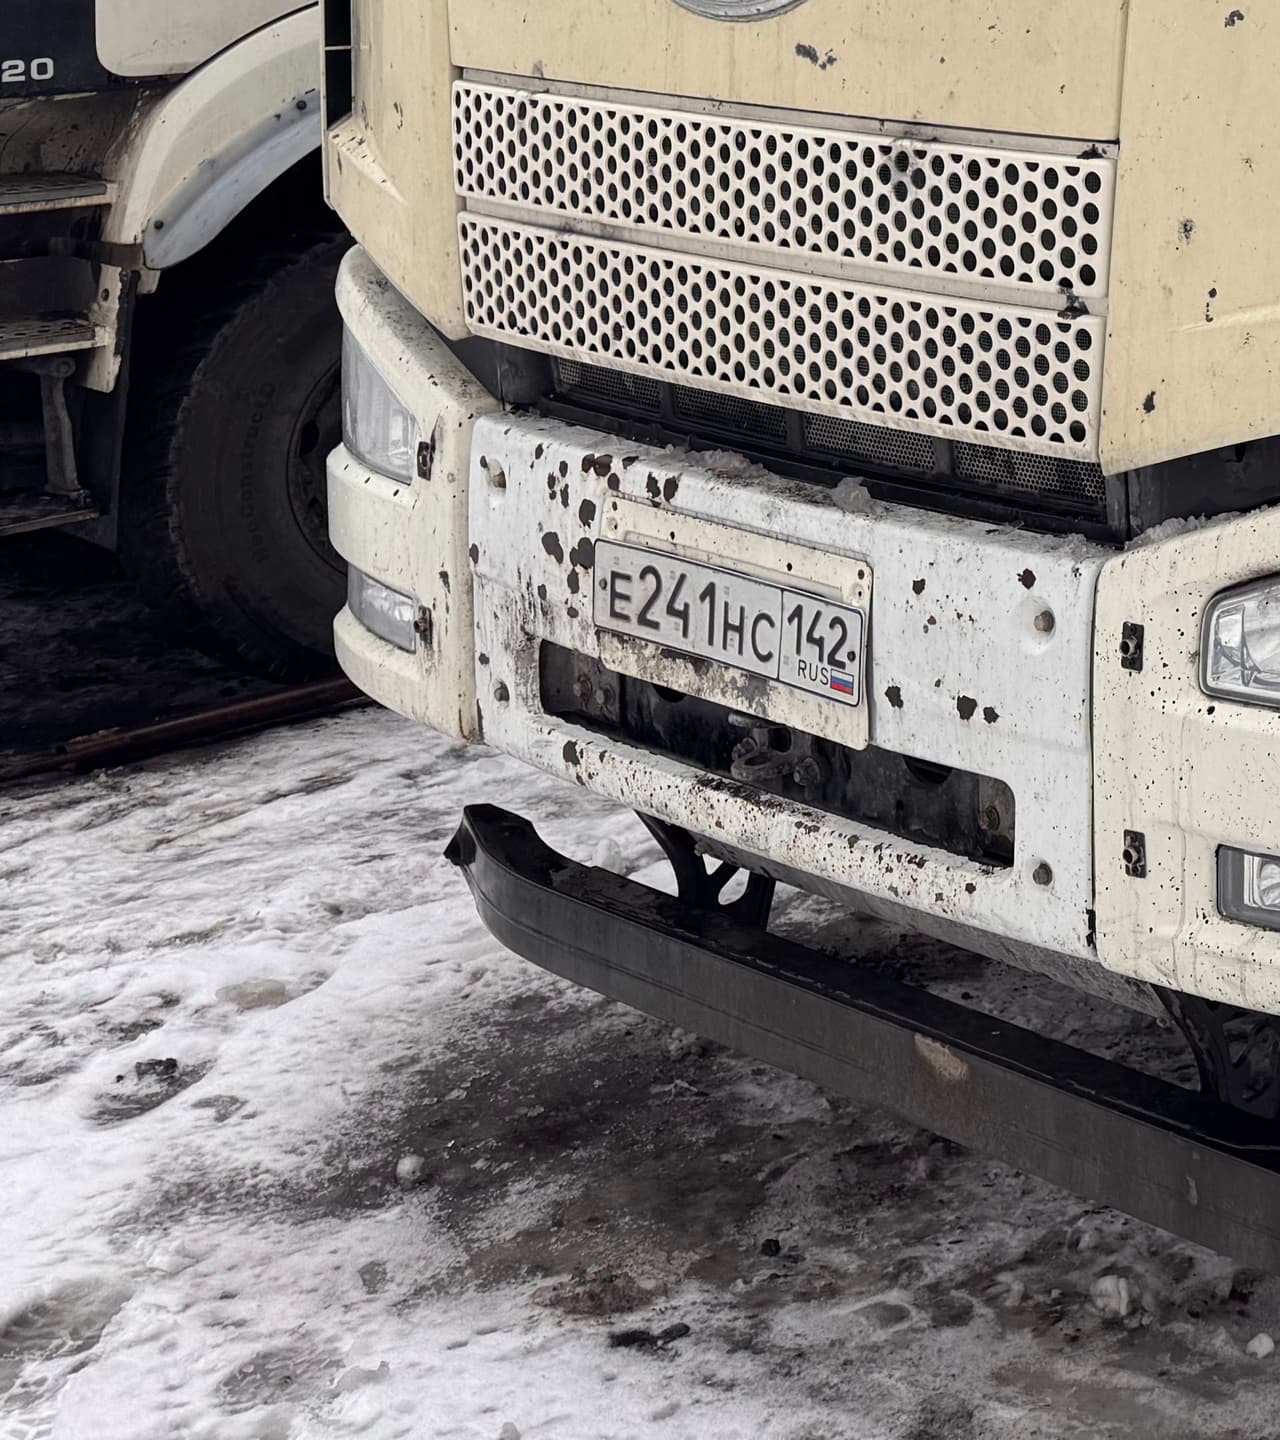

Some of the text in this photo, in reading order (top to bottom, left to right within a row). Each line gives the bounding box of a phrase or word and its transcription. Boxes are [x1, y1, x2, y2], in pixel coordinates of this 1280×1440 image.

[1, 57, 55, 83] 20
[787, 603, 848, 670] 142
[797, 658, 830, 686] RUS
